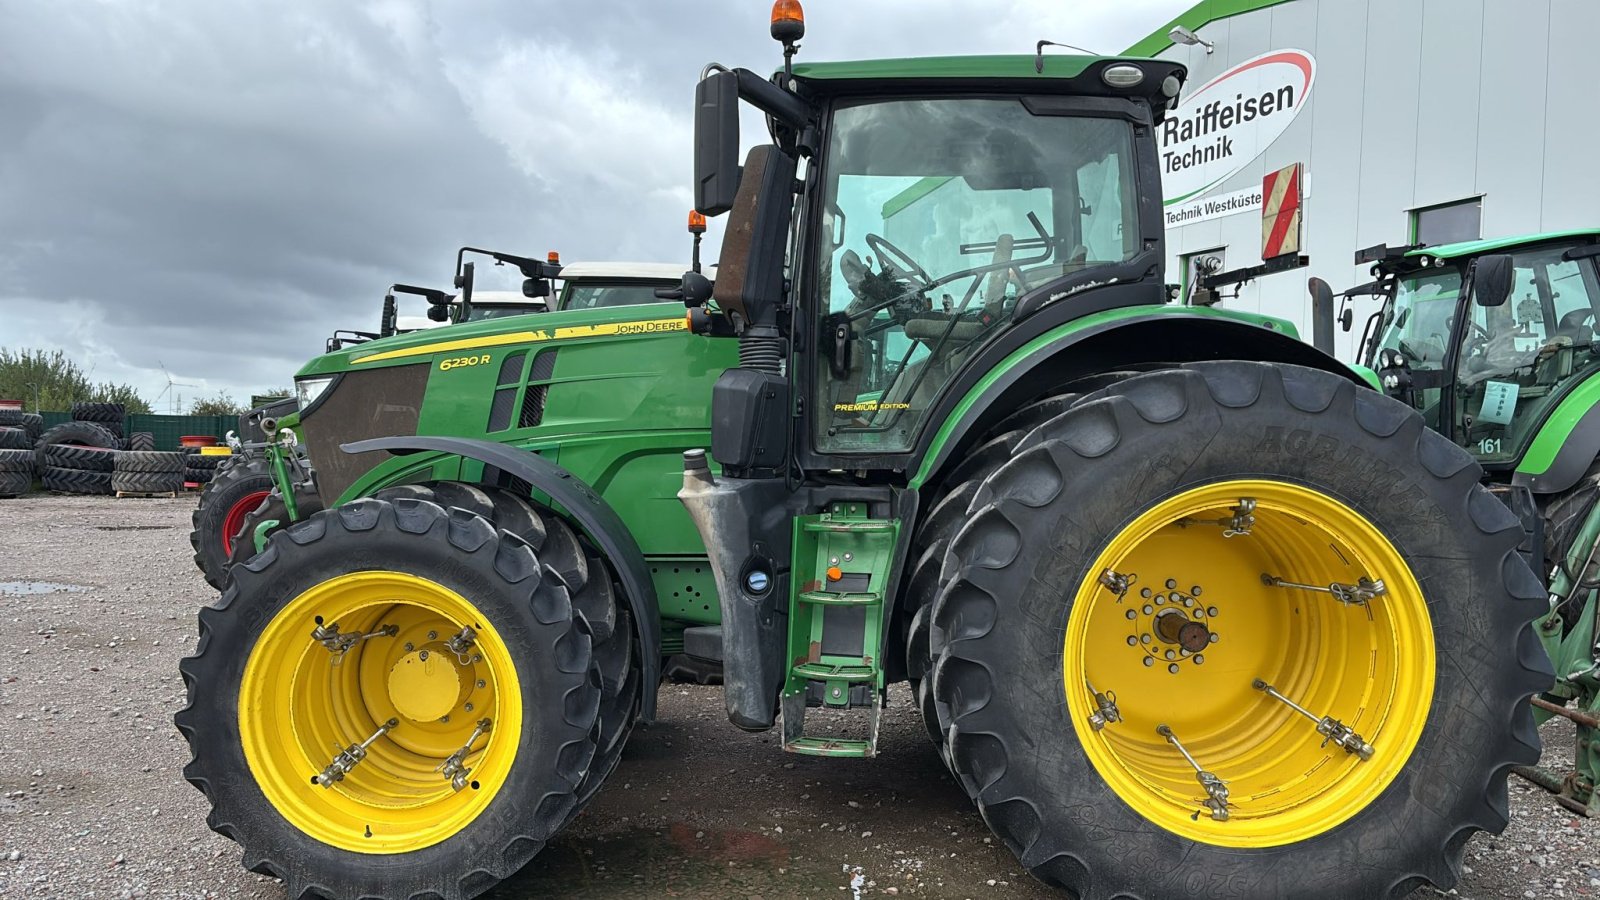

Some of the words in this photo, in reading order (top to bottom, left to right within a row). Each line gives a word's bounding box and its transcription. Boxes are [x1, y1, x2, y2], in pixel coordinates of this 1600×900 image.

[1163, 85, 1294, 147] Raiffeisen
[1163, 135, 1233, 174] Technik
[1166, 203, 1203, 224] Technik
[1204, 191, 1262, 215] Westküste
[614, 324, 644, 334] JOHN
[646, 321, 683, 331] DEERE
[439, 355, 479, 371] 6230
[480, 354, 491, 365] R
[834, 403, 878, 412] PREMIUM
[1477, 438, 1501, 455] 161
